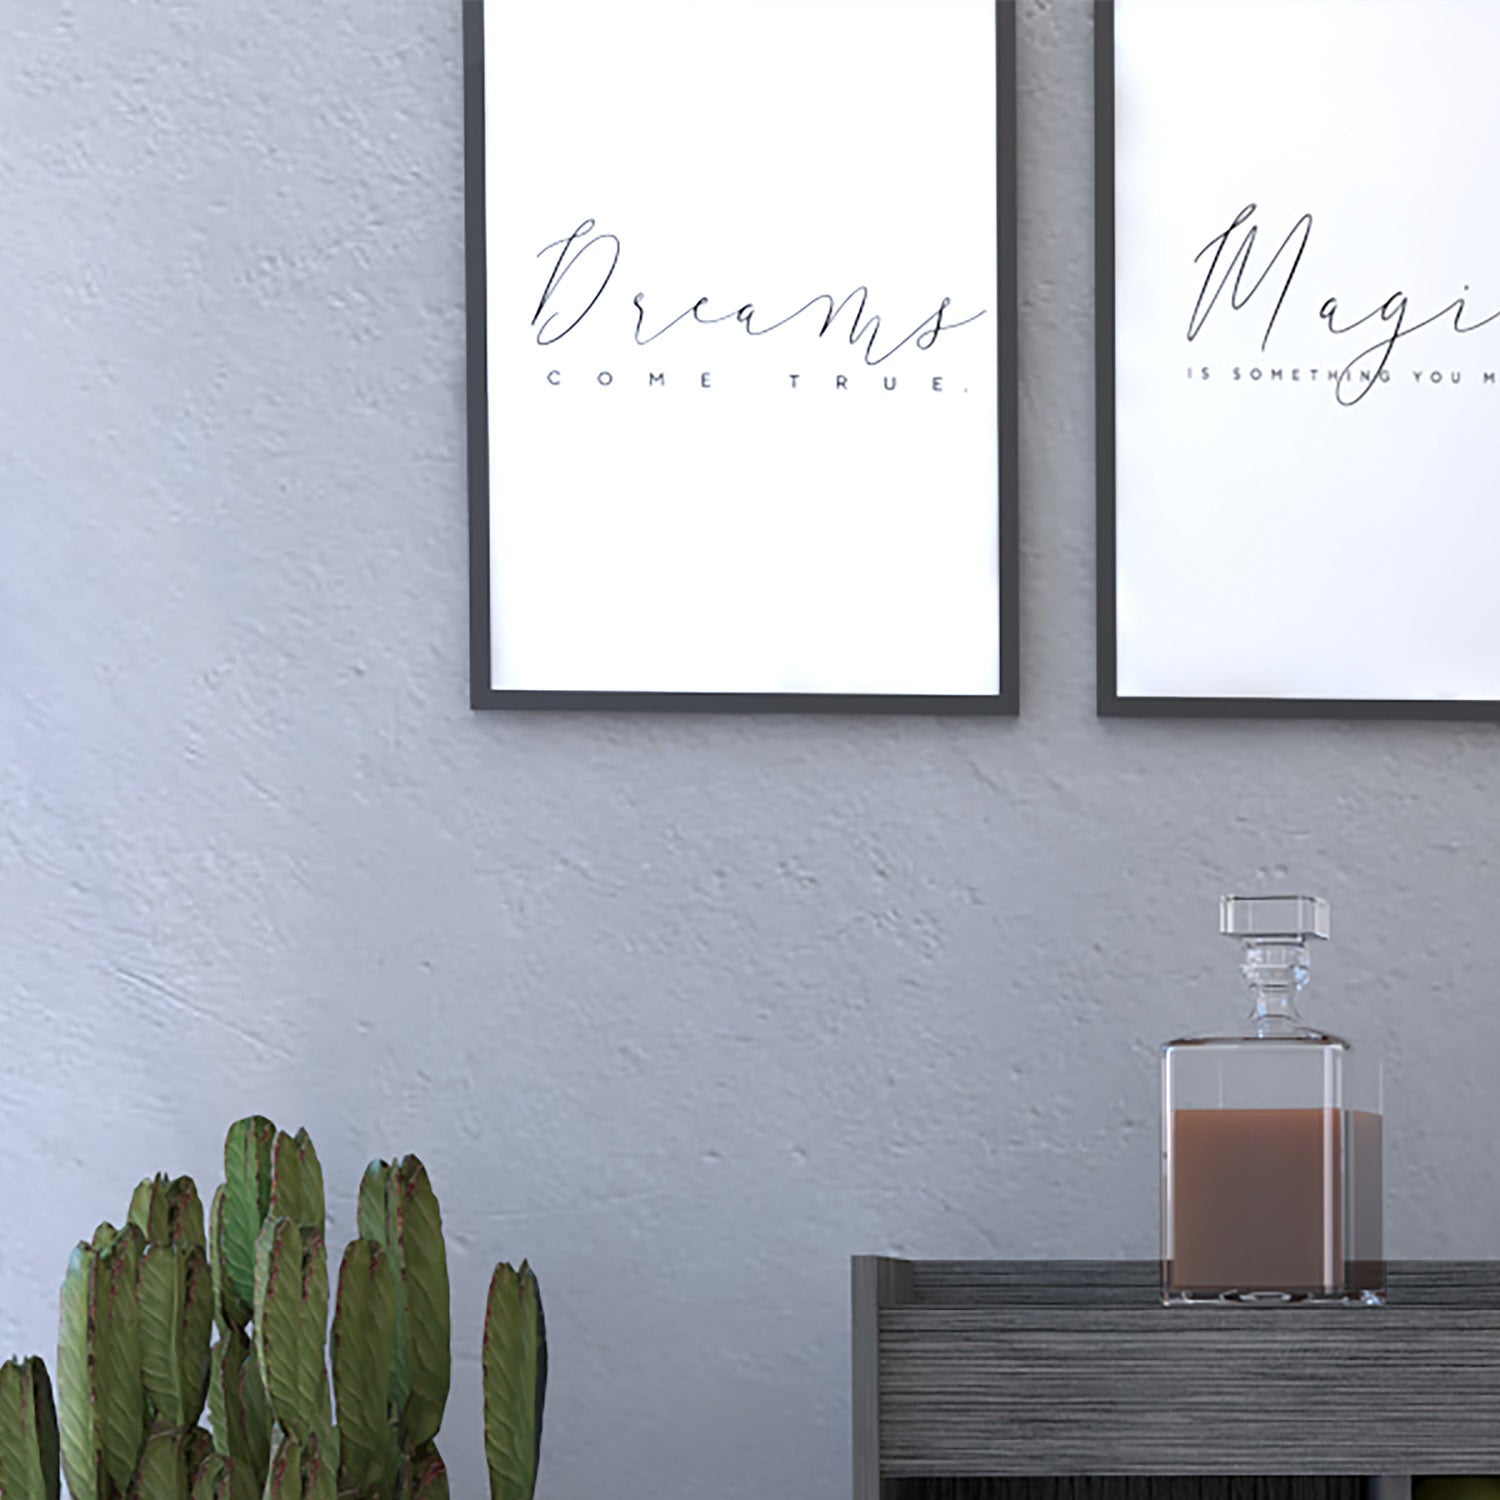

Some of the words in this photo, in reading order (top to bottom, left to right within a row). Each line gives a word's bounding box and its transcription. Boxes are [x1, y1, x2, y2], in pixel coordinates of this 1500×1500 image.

[530, 217, 987, 366] Dreams
[546, 369, 711, 389] COME
[788, 373, 968, 393] TRUE.
[1187, 366, 1210, 381] IS
[1232, 366, 1392, 384] SOMETHING
[1412, 370, 1462, 385] YOU
